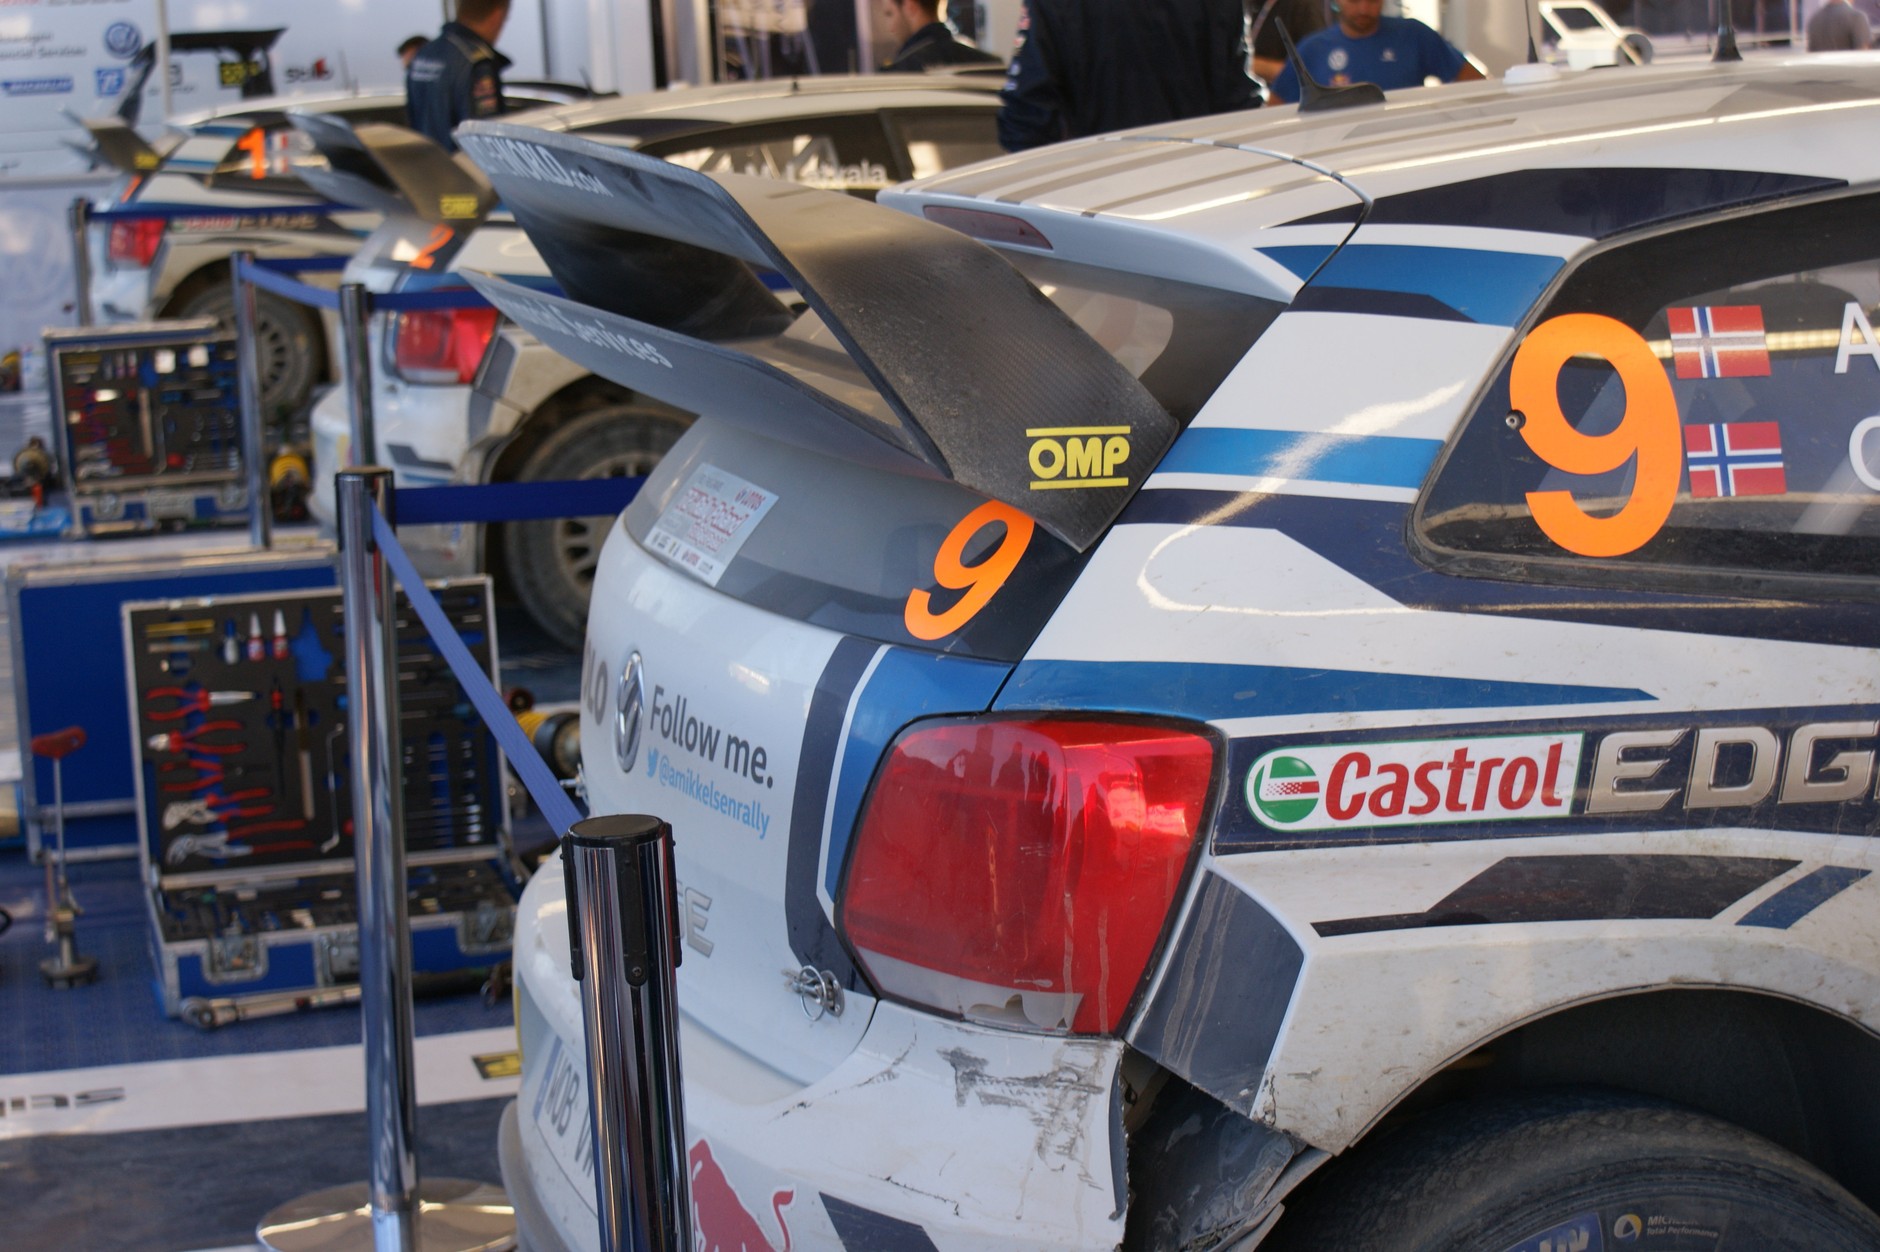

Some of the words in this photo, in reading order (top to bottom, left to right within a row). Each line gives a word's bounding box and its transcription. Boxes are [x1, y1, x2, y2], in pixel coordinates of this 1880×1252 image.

[237, 128, 266, 179] 1
[409, 224, 455, 270] 2
[1028, 436, 1131, 480] OMP
[1509, 312, 1682, 558] 9
[904, 499, 1036, 641] 9
[650, 684, 721, 762] Follow
[724, 732, 774, 789] me.
[1325, 742, 1564, 821] Castrol
[1585, 720, 1880, 814] EDG
[658, 754, 770, 840] @amikkelsenrally
